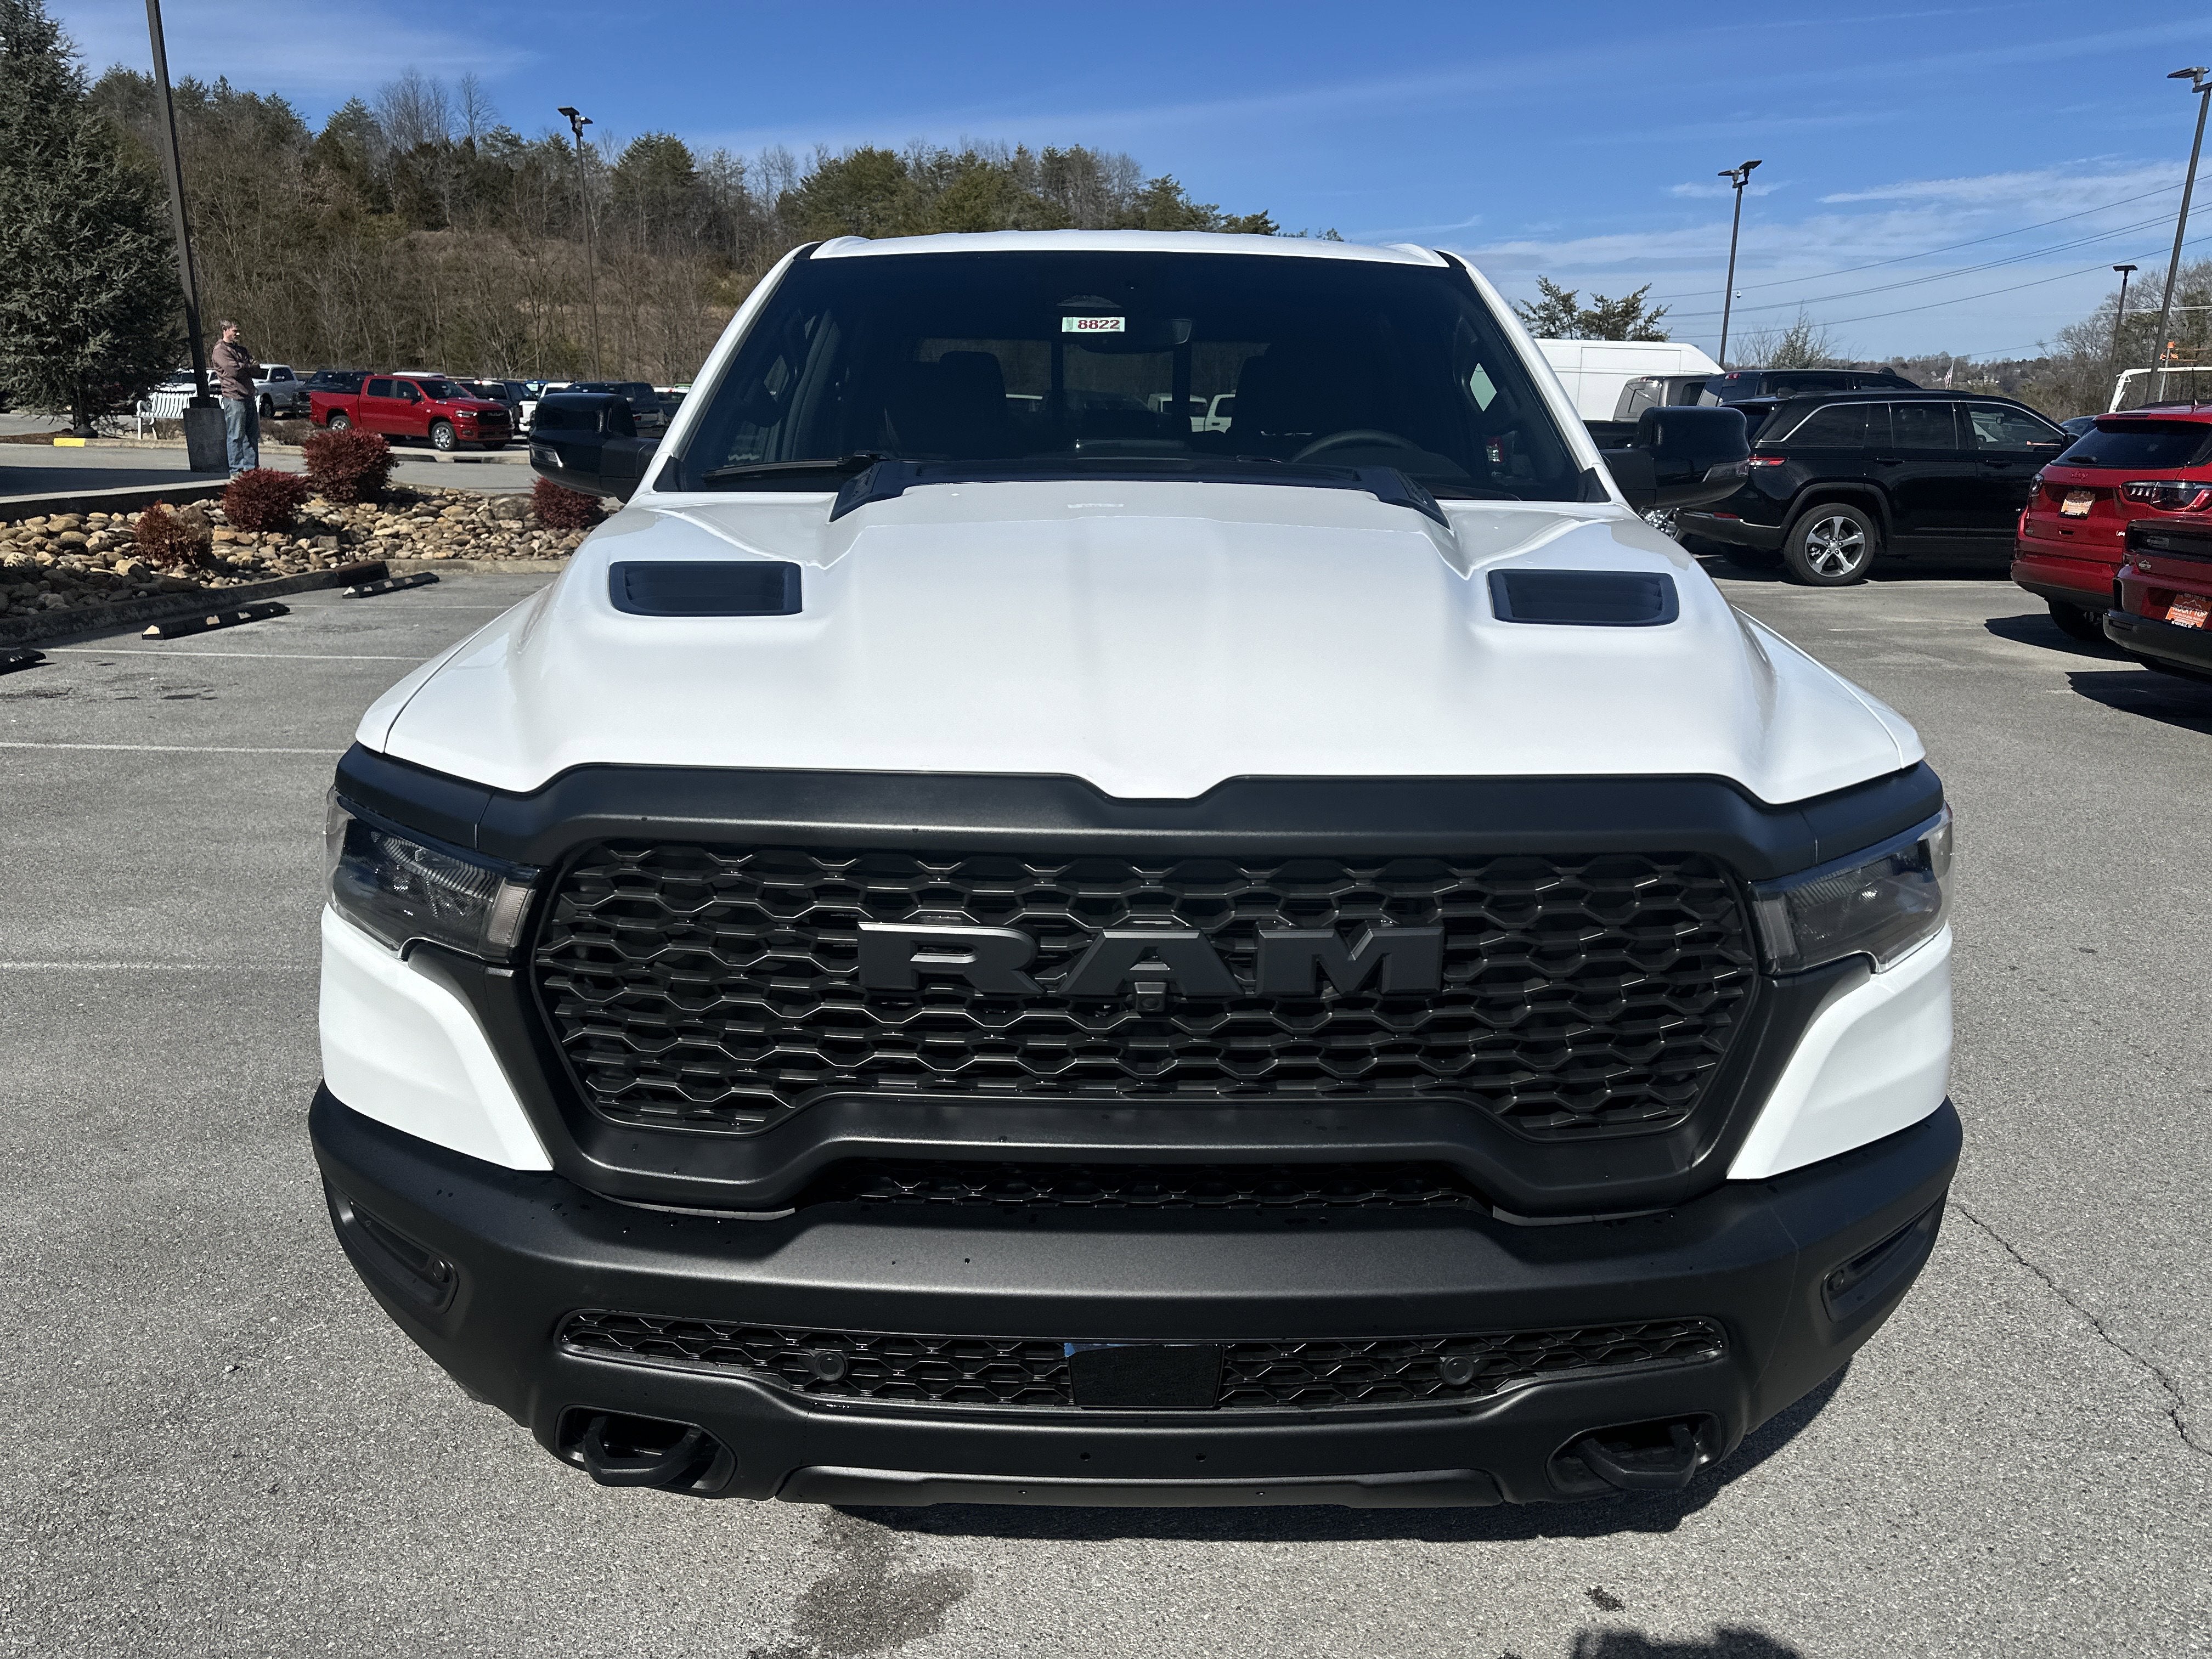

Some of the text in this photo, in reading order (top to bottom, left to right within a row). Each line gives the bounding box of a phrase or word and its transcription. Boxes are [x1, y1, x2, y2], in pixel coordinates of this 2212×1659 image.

[1077, 319, 1120, 329] 8822
[2174, 603, 2194, 614] ROCKY
[2194, 608, 2209, 617] TOP
[857, 921, 1445, 997] RAM
